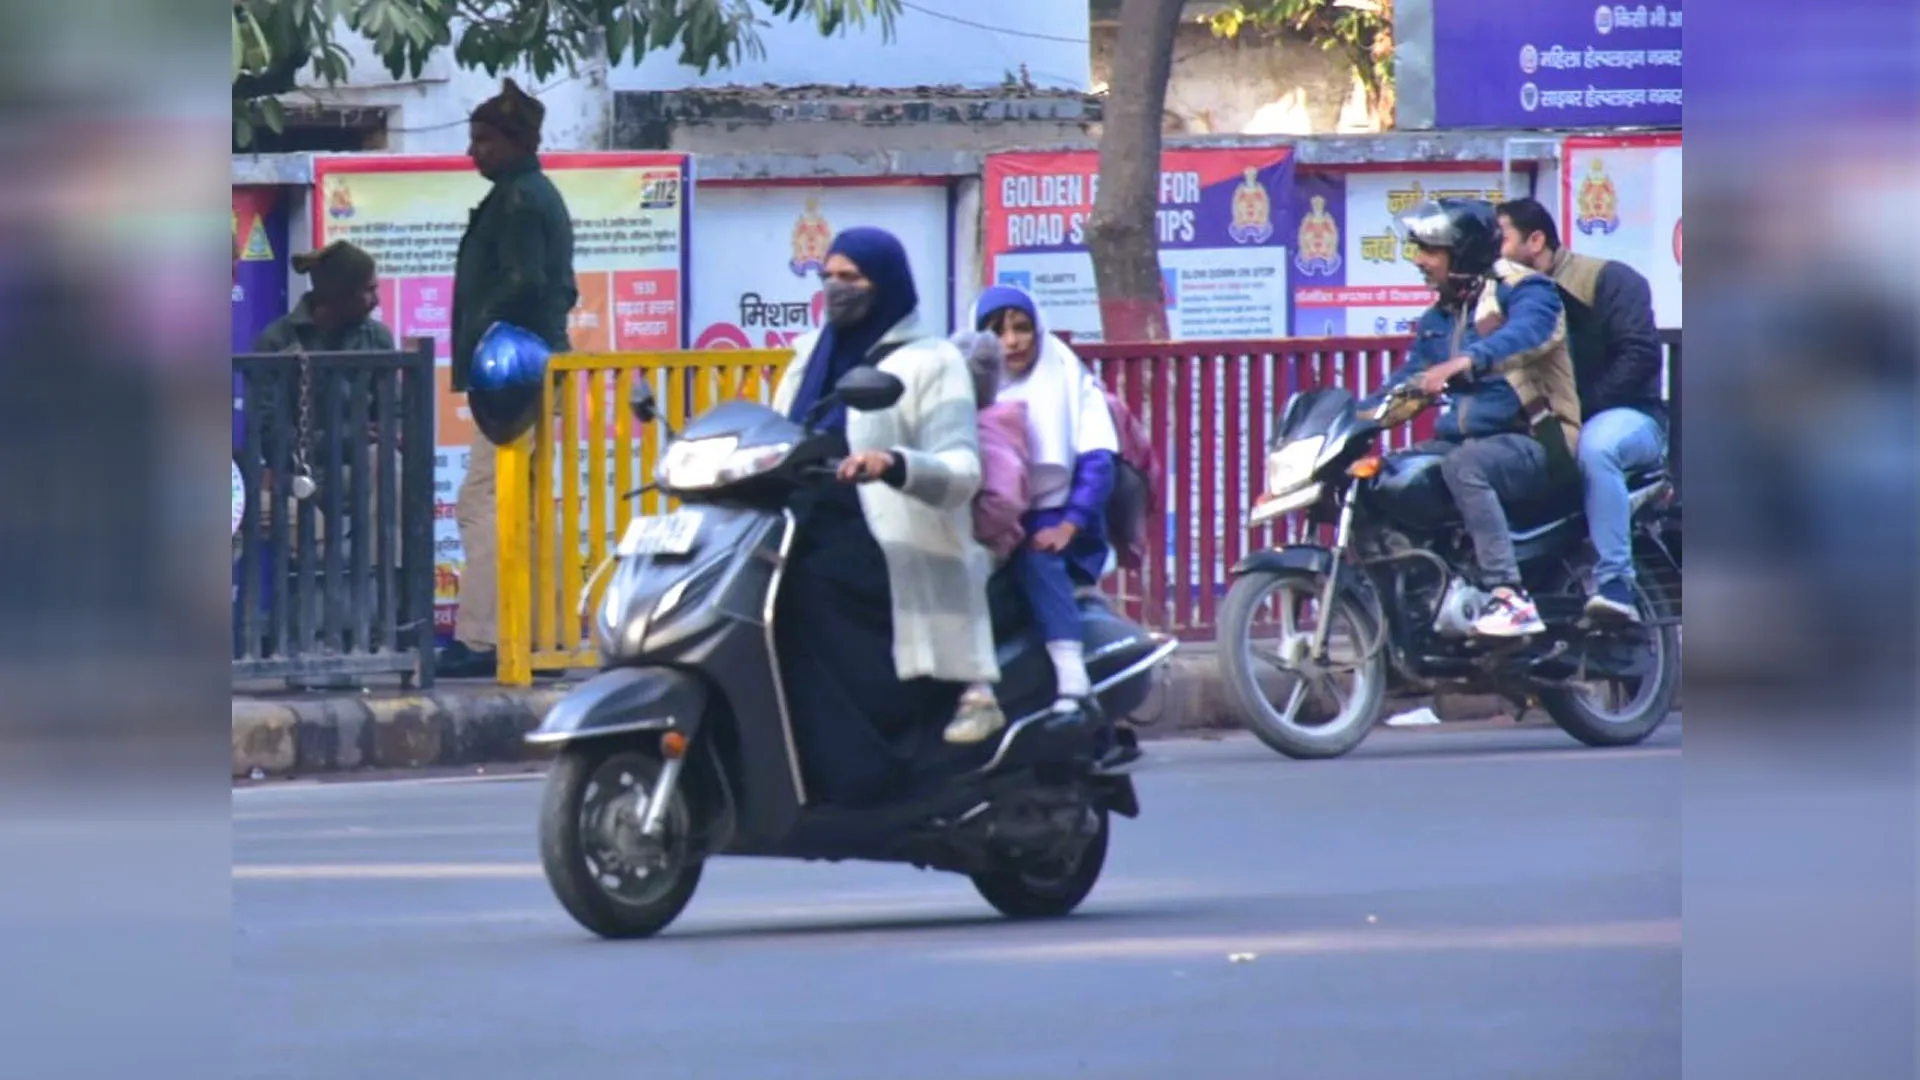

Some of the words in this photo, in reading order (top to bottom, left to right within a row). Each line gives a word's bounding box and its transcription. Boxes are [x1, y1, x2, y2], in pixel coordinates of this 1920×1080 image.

[1650, 5, 1666, 28] भी
[1540, 45, 1581, 69] महिला
[1584, 45, 1645, 69] हेल्पलाइन
[1540, 90, 1582, 109] साइबर
[1585, 84, 1646, 108] हेल्पलाइन
[654, 180, 677, 200] 112
[1002, 174, 1082, 207] GOLDEN
[1160, 172, 1200, 204] FOR
[1008, 213, 1064, 246] ROAD
[1155, 210, 1195, 242] IPS
[740, 292, 809, 327] मिशन
